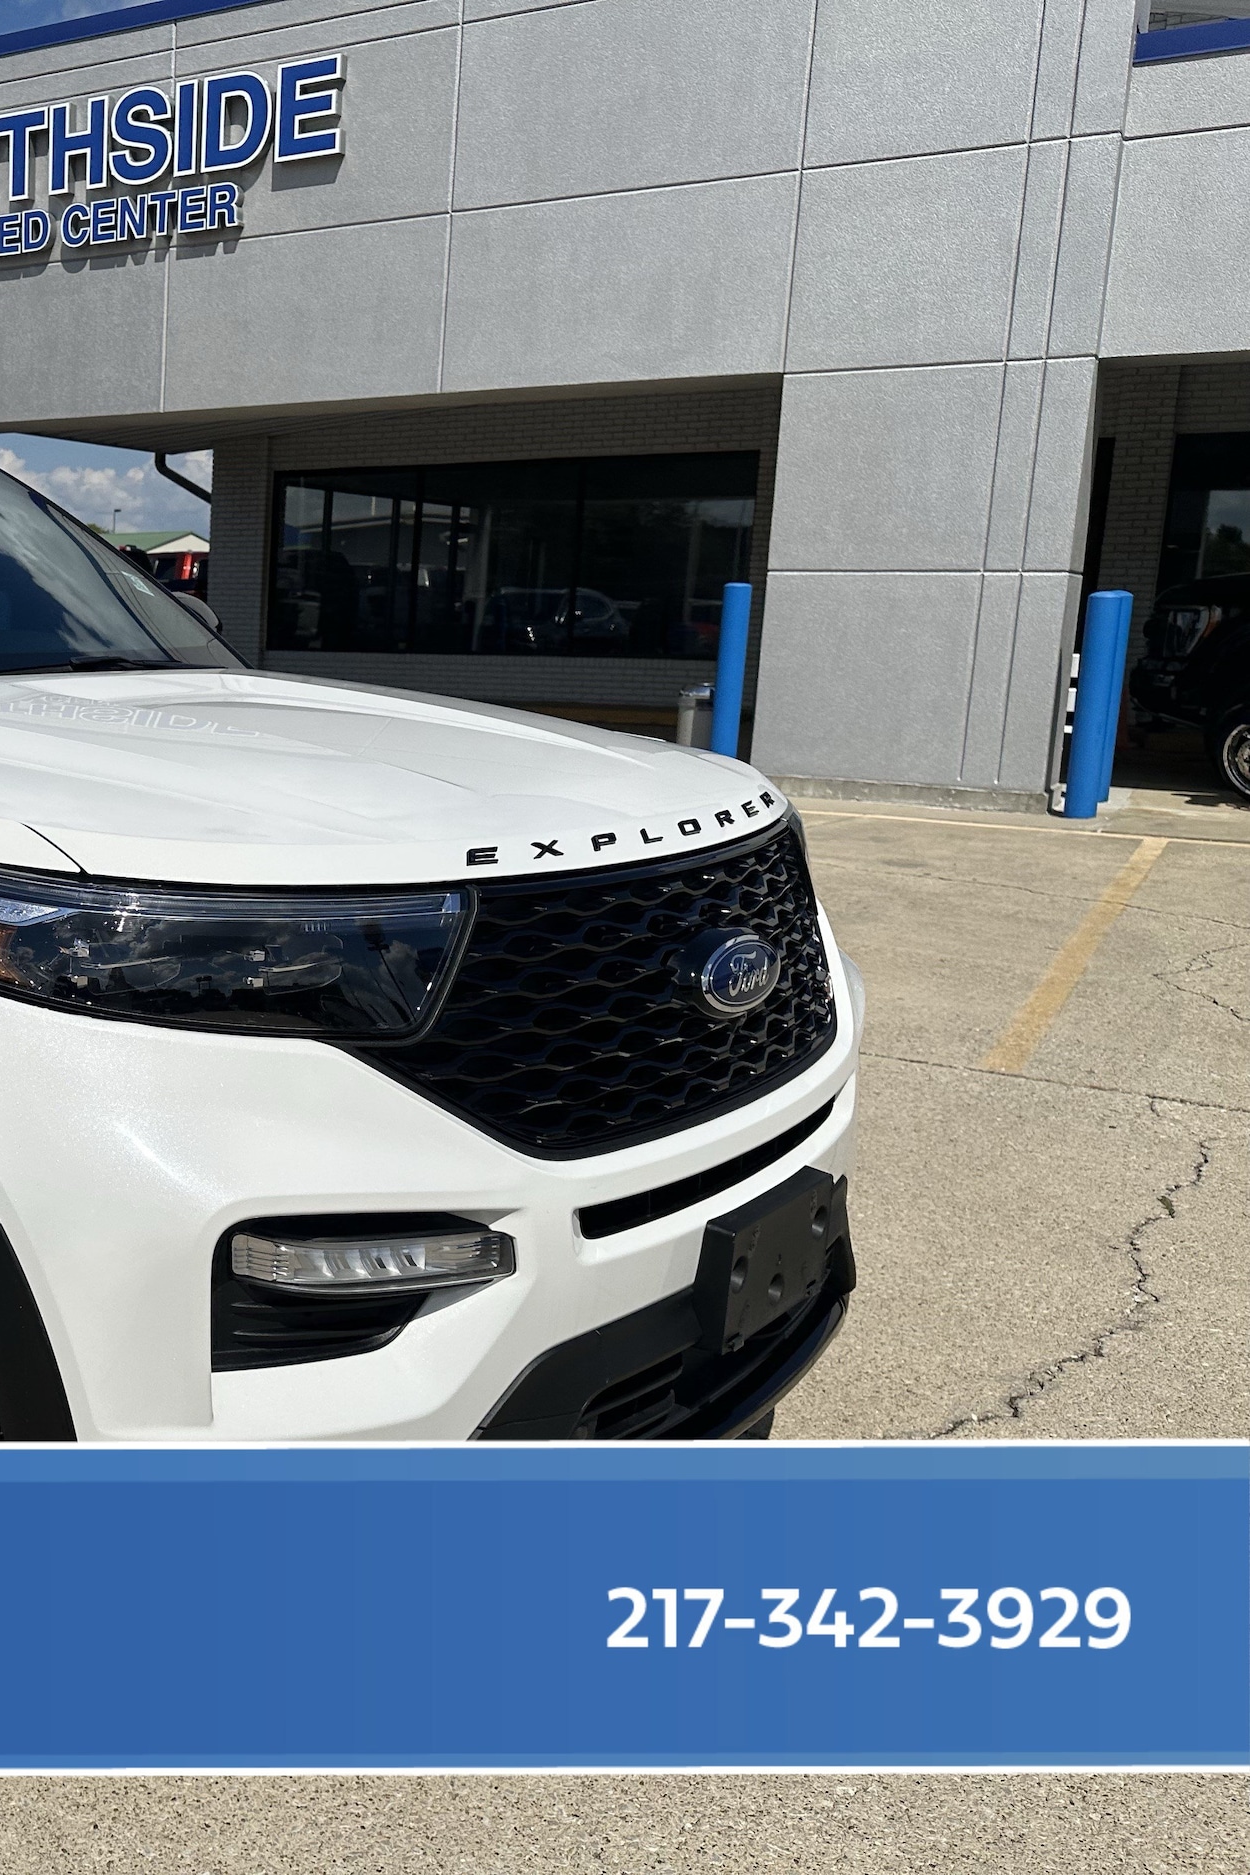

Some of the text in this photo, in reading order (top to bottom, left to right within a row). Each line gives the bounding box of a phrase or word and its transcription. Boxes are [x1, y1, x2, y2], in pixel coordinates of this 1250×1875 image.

[61, 181, 242, 248] CENTER
[466, 791, 775, 866] EXPLORER
[728, 951, 770, 997] Ford
